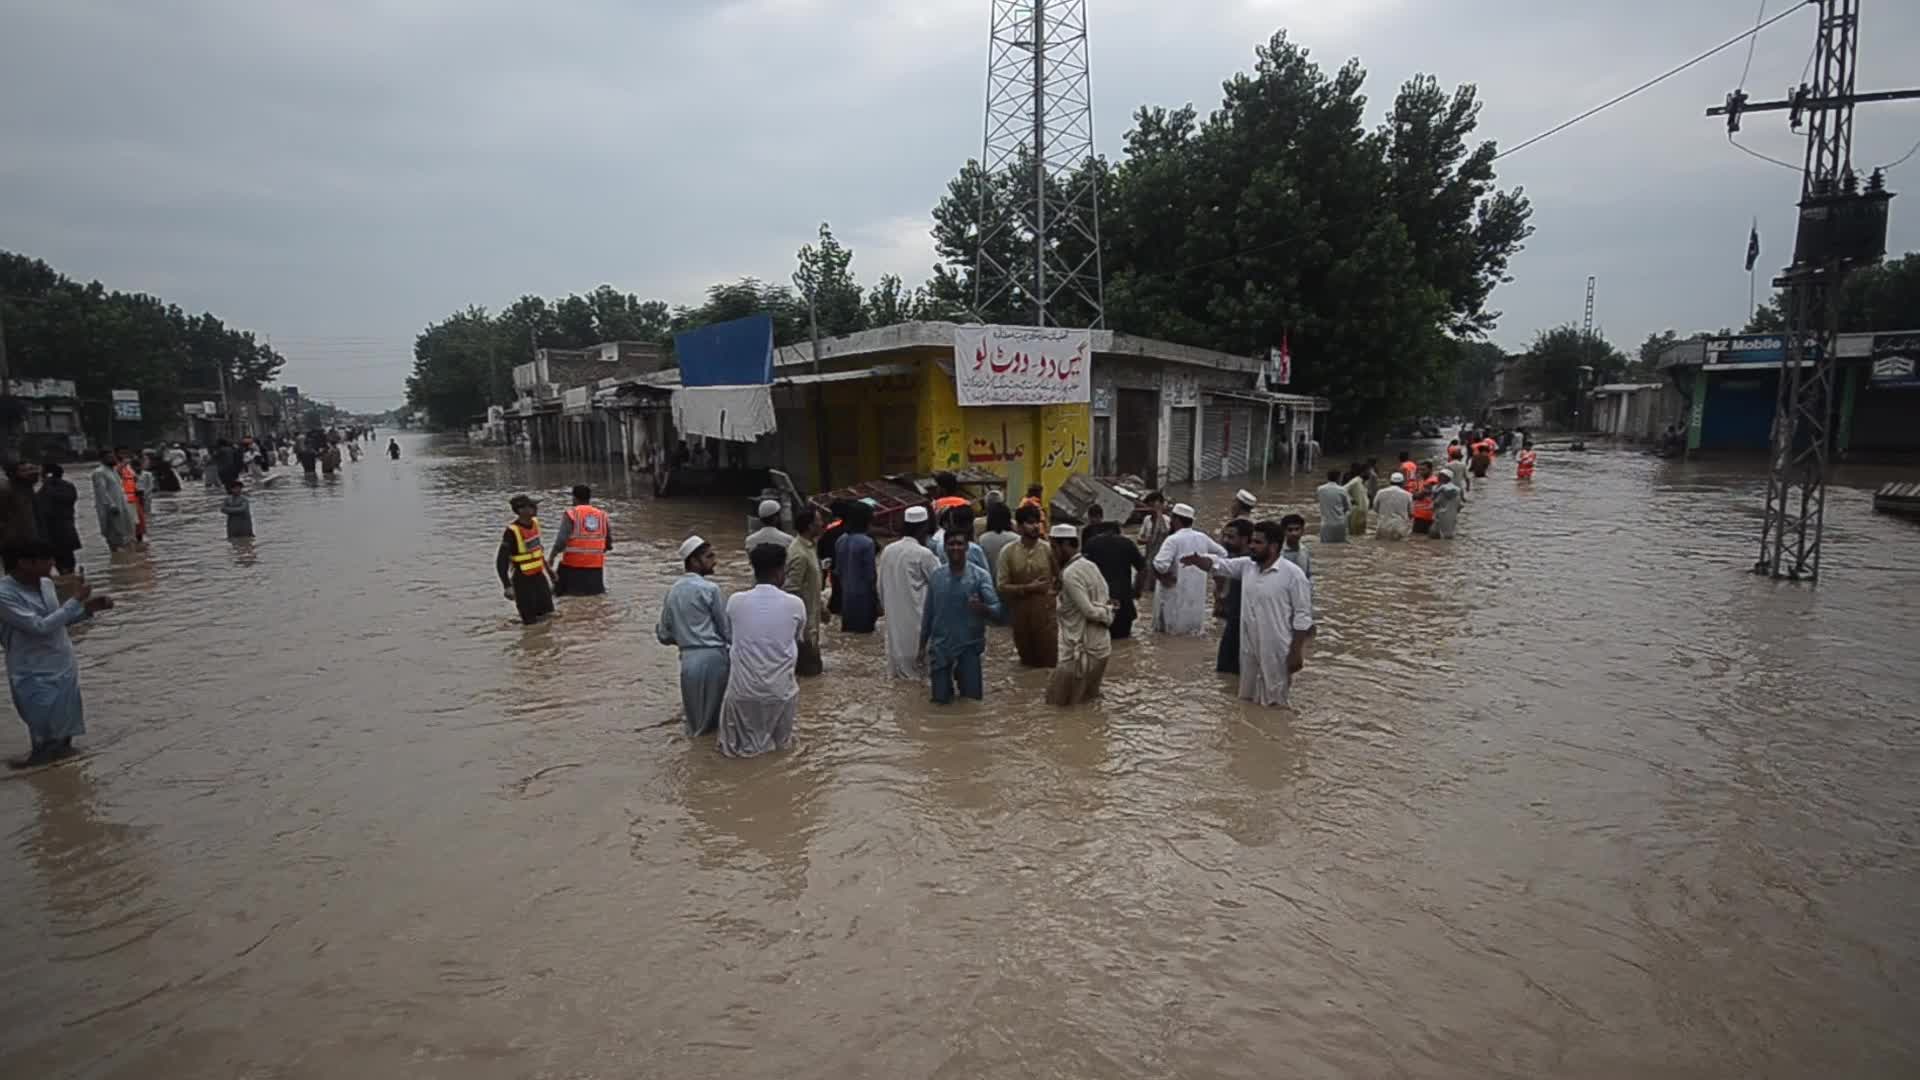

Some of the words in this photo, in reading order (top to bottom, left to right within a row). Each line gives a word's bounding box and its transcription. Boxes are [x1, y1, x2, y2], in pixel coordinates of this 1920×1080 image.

[973, 335, 987, 370] لو
[1057, 340, 1088, 380] گیس
[1732, 338, 1781, 350] Mobile
